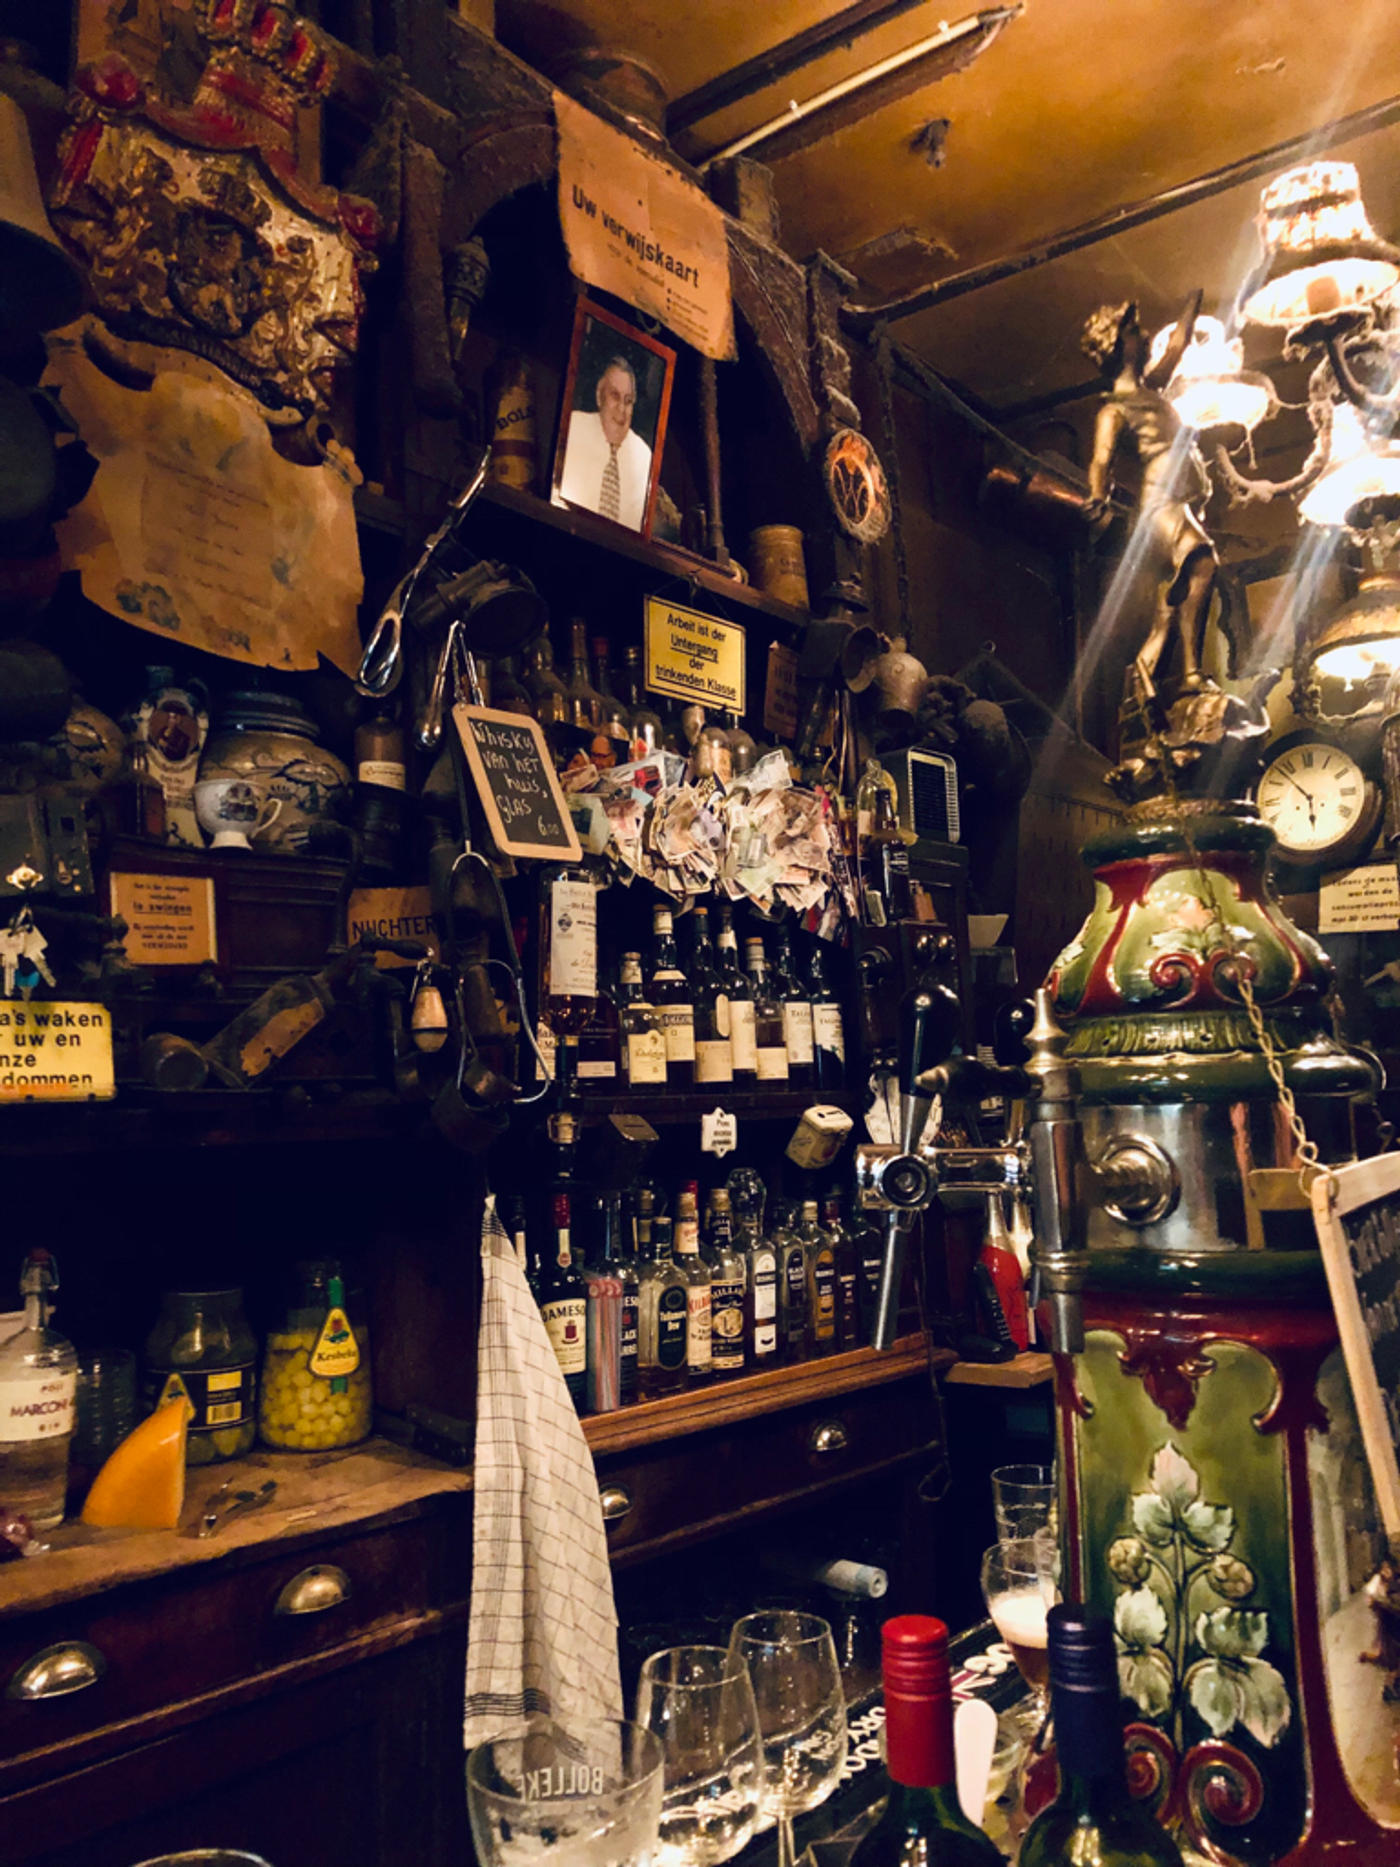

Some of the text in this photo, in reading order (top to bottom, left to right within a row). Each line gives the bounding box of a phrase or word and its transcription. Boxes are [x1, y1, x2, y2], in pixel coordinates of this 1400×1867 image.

[573, 184, 597, 219] Uw
[602, 210, 699, 288] verwijskaart
[667, 613, 726, 642] Arbeit ist der
[670, 633, 718, 663] Untergang
[689, 657, 704, 670] der
[655, 664, 737, 697] trinkenden Klasse
[470, 721, 535, 755] Whisky
[34, 1010, 103, 1027] waken
[15, 1033, 81, 1047] uw en
